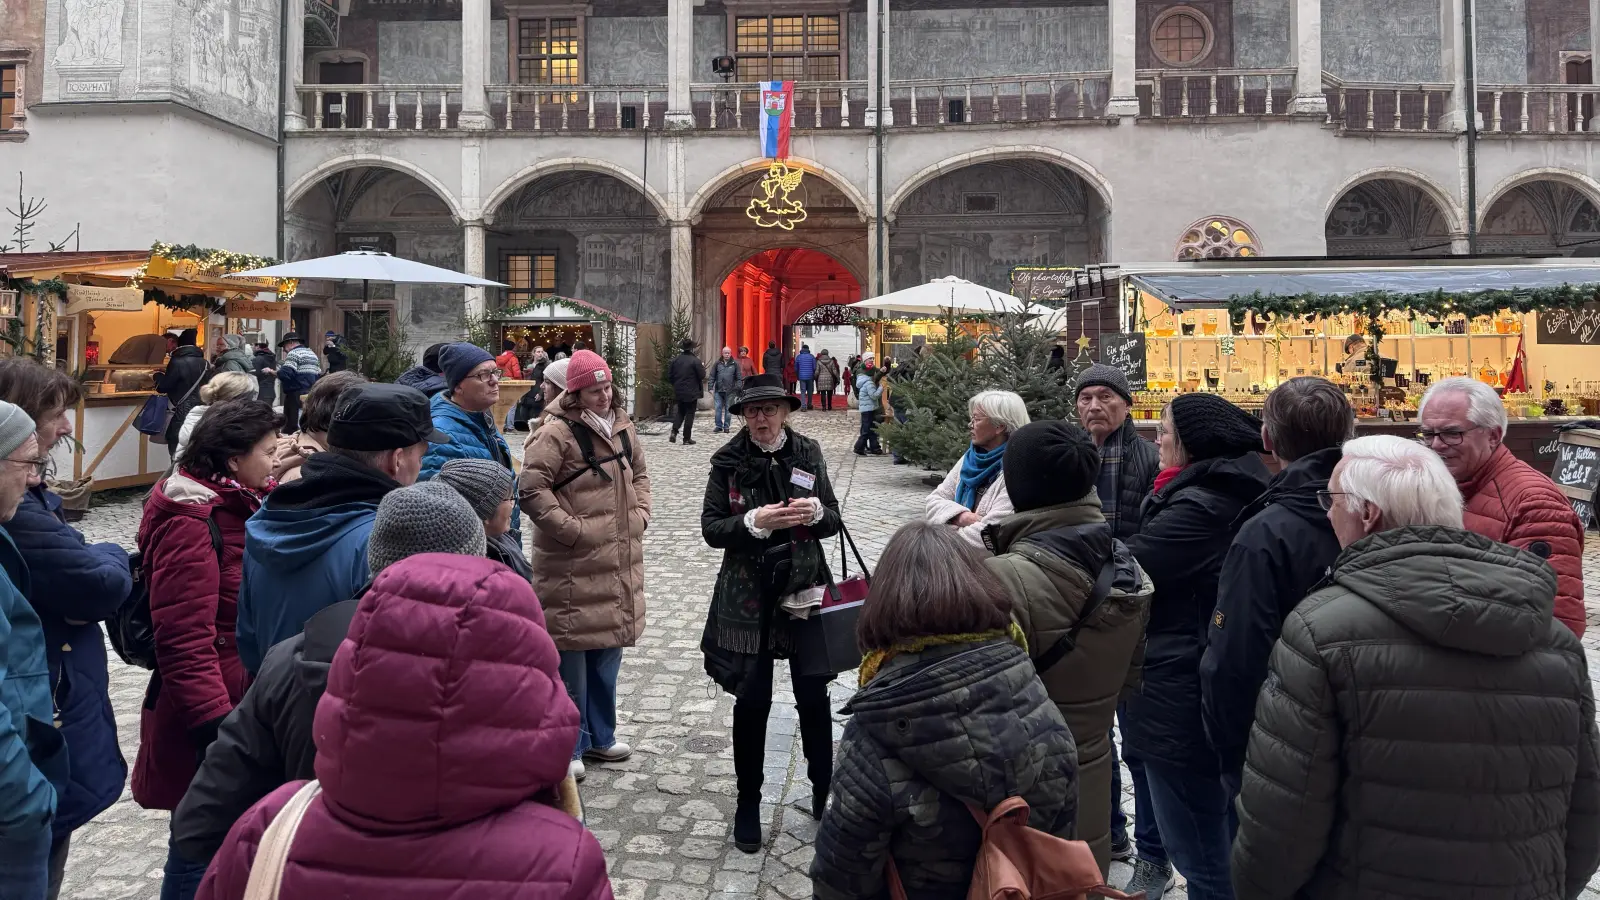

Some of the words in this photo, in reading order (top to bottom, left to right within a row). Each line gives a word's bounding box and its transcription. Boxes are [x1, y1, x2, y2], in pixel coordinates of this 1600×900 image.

[68, 82, 110, 92] JOSAPHAT
[1106, 345, 1118, 356] Ein
[1562, 446, 1574, 462] Wir
[1574, 446, 1597, 462] füllen
[1559, 467, 1572, 482] Sie
